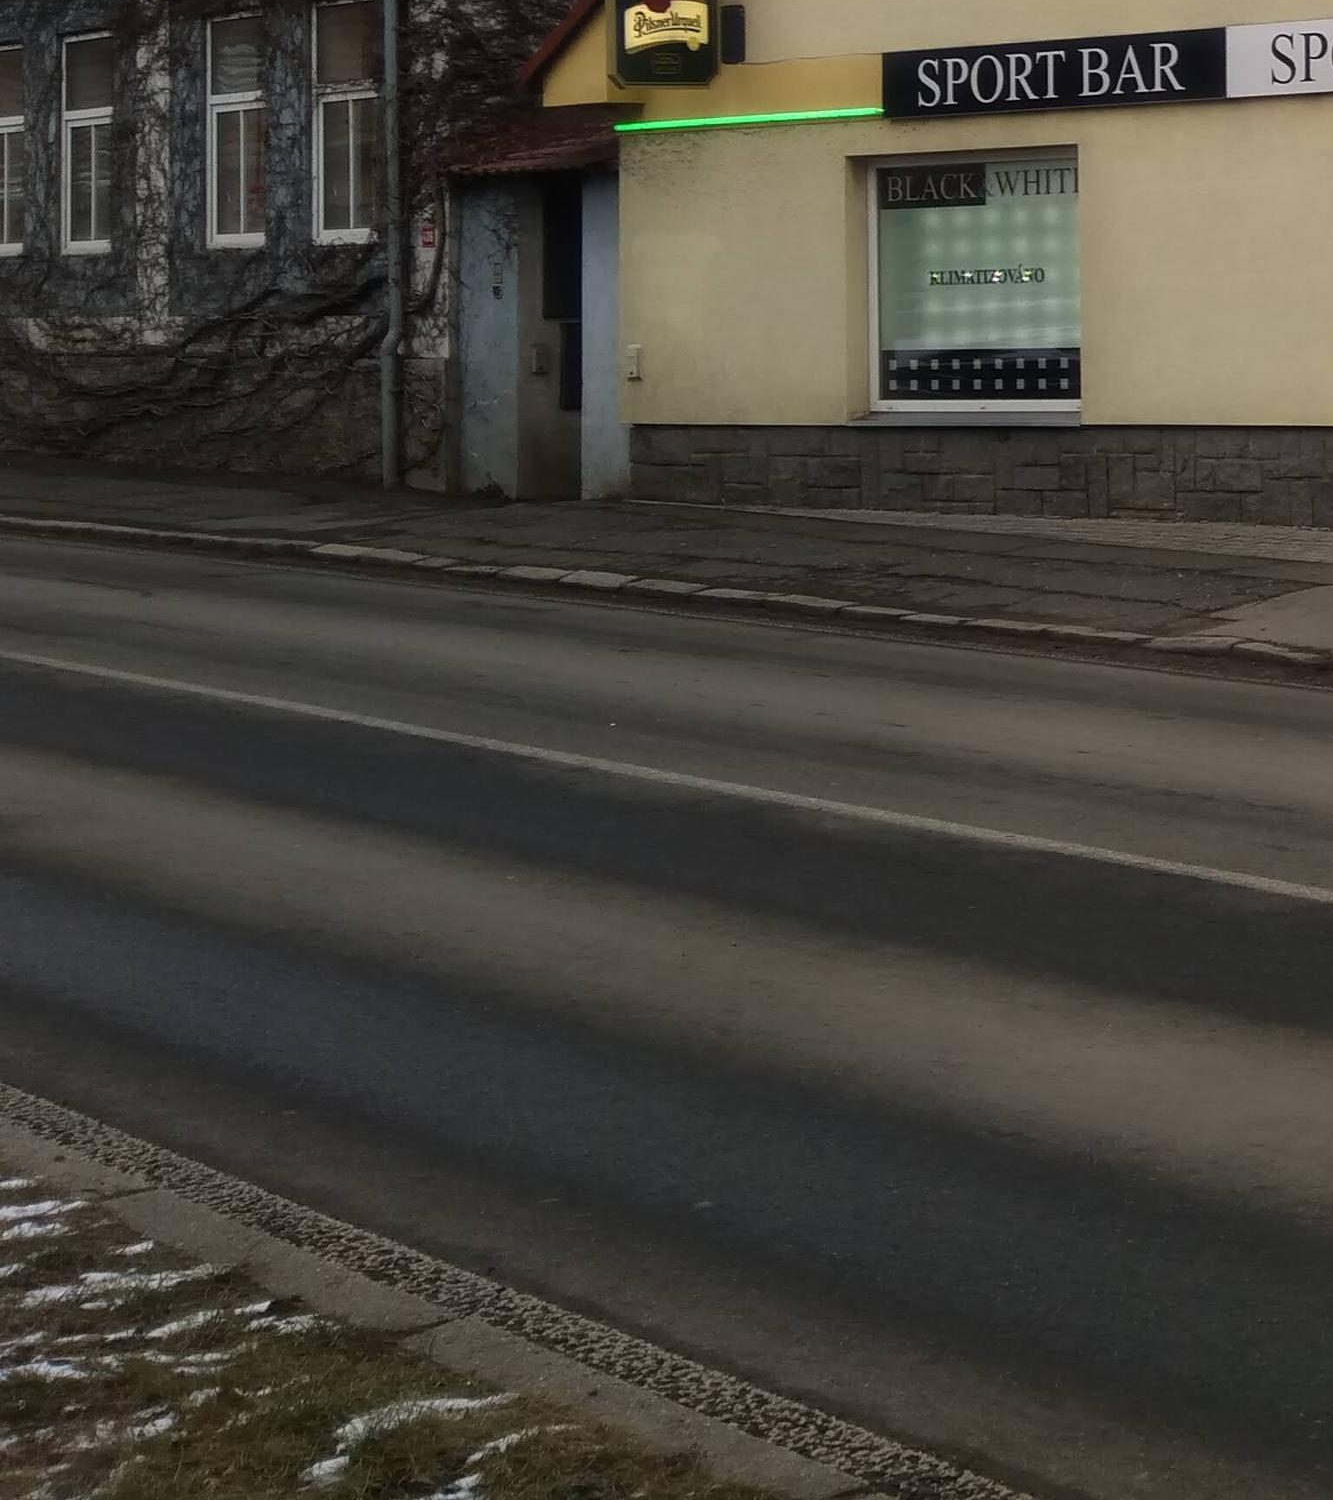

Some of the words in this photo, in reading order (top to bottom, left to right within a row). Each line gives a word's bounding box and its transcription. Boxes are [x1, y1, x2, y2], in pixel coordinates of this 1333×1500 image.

[633, 11, 670, 38] Pilsner
[917, 49, 1066, 108] SPORT
[1077, 42, 1186, 98] BAR
[887, 173, 979, 202] BLACK
[929, 264, 1045, 286] KLIMATIZOVÁNO
